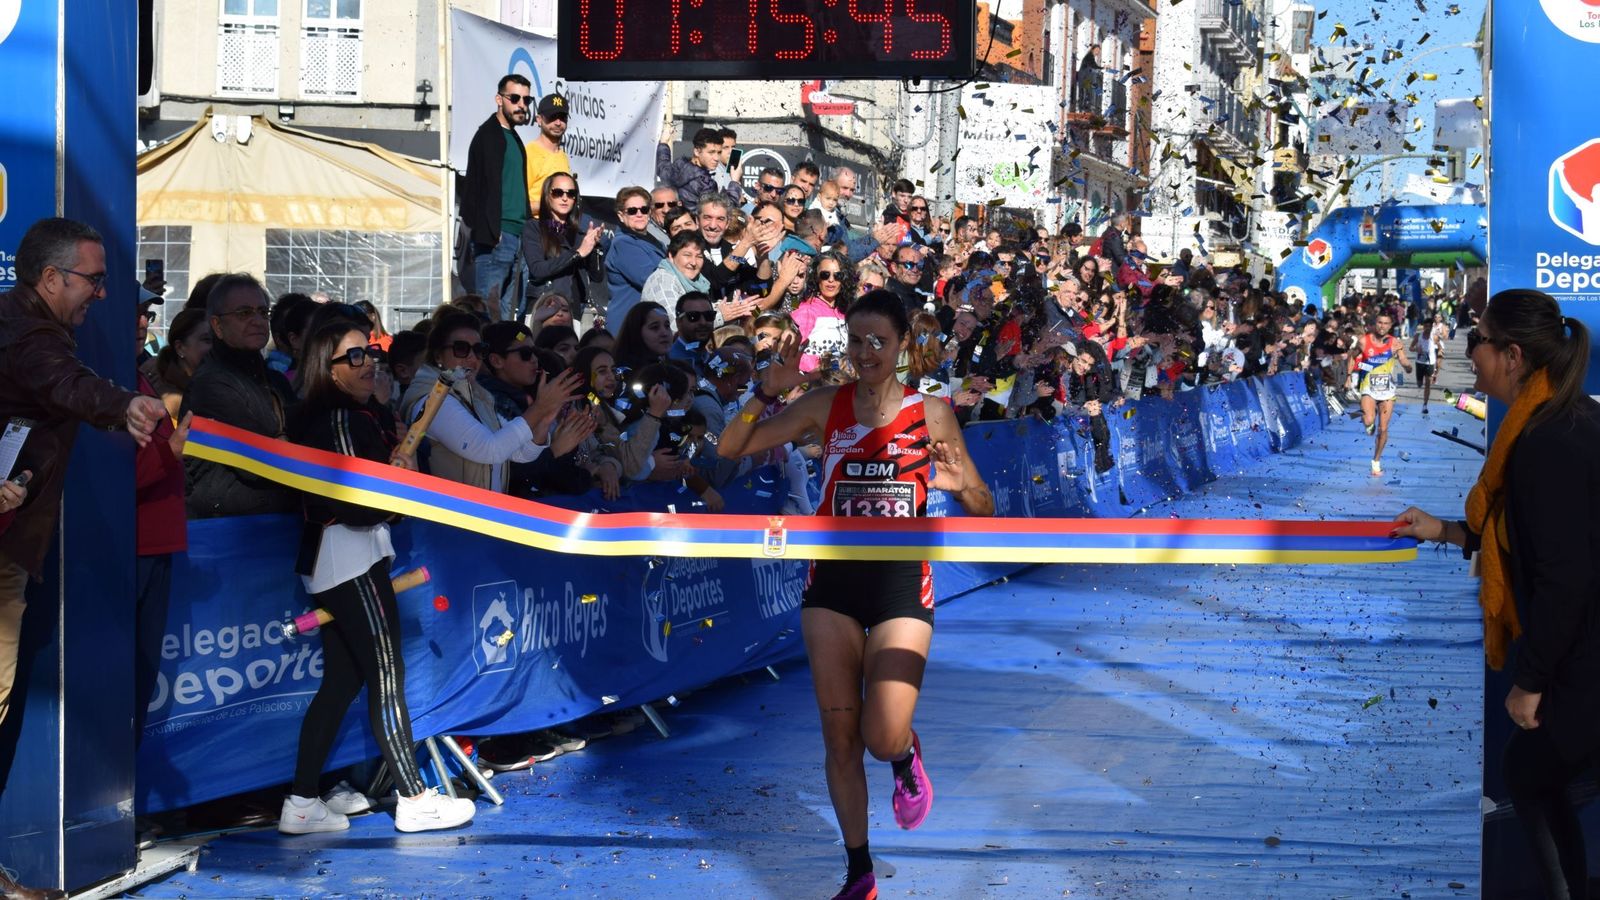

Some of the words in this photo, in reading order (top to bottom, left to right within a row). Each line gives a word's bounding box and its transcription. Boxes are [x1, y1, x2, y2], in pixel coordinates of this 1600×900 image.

[1579, 20, 1595, 28] Los
[555, 81, 606, 120] Servicios
[559, 127, 624, 163] Ambientales
[864, 463, 894, 476] BM
[670, 575, 725, 619] Deportes
[520, 583, 560, 653] Brico
[564, 581, 609, 659] Reyes
[147, 642, 324, 712] Deporte
[249, 697, 293, 714] Palacios
